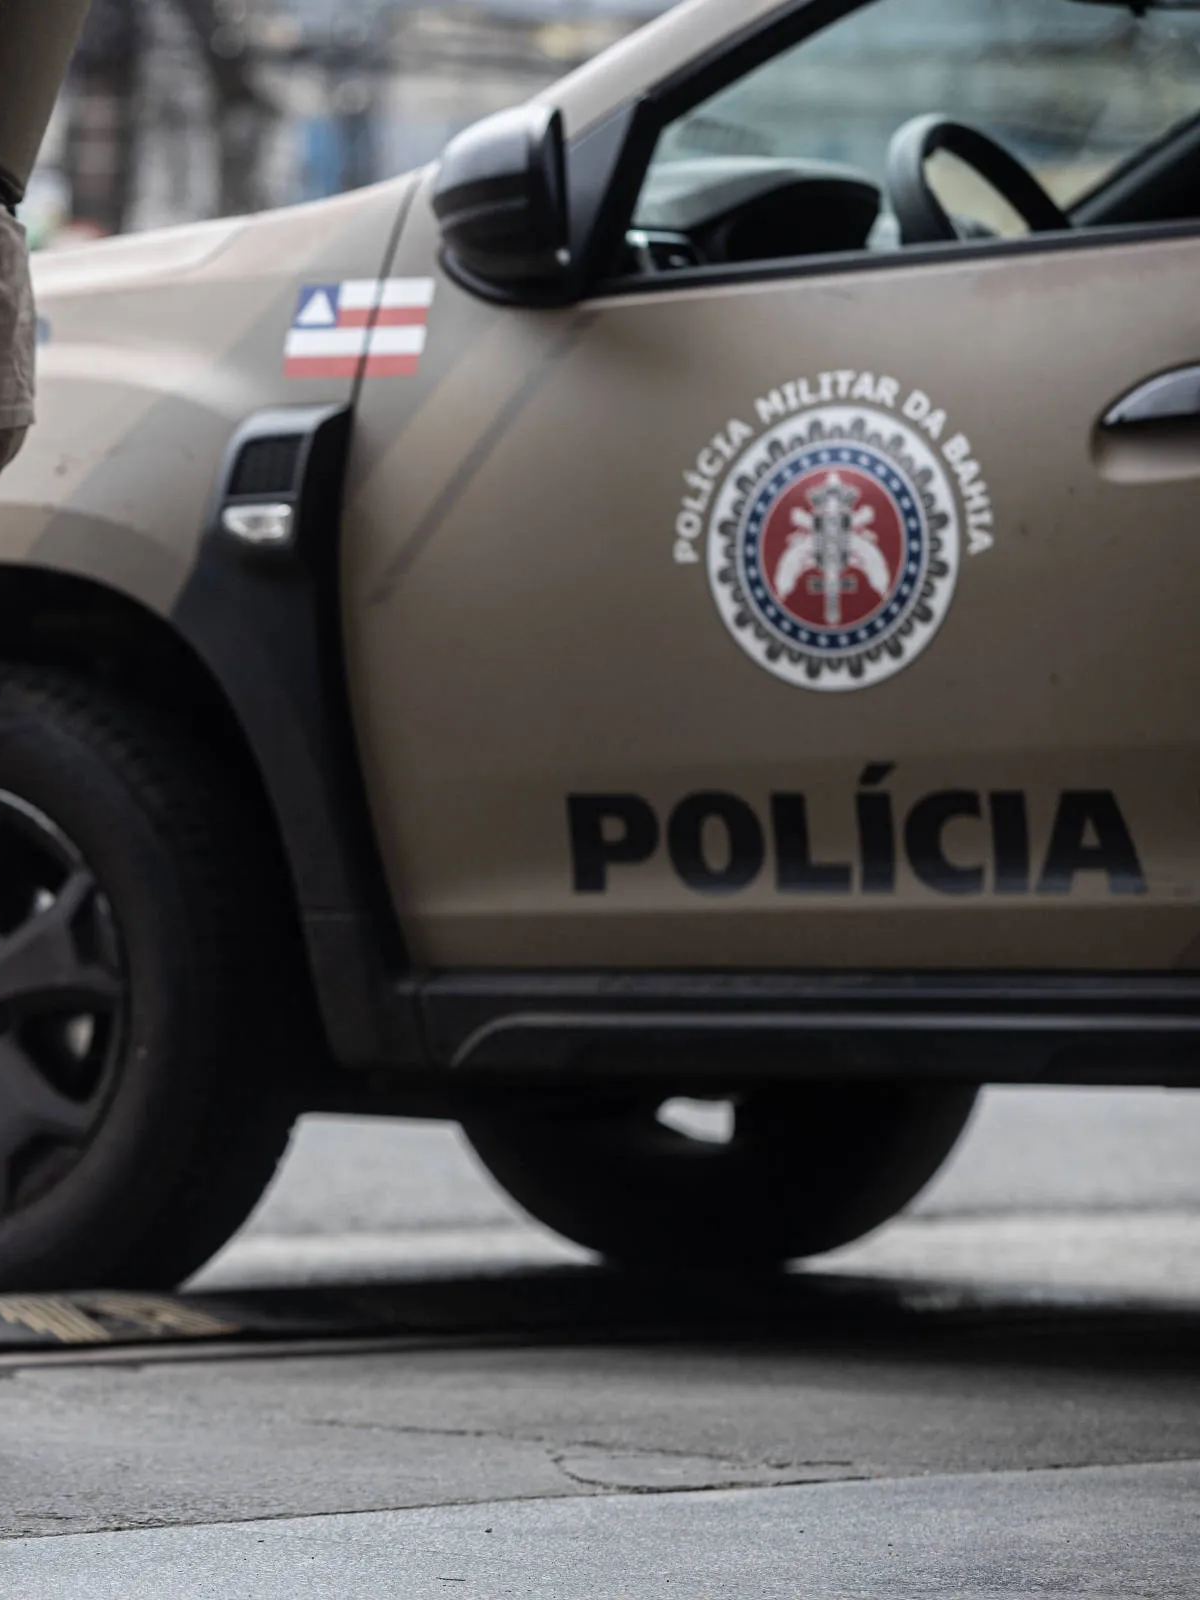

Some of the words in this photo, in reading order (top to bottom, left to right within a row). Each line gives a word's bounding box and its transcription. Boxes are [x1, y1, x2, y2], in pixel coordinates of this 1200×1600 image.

[673, 418, 754, 564] POLÍCIA
[753, 369, 901, 424] MILITAR
[901, 389, 947, 441] DA
[941, 432, 994, 556] BAHIA
[566, 762, 1149, 895] POLÍCIA
